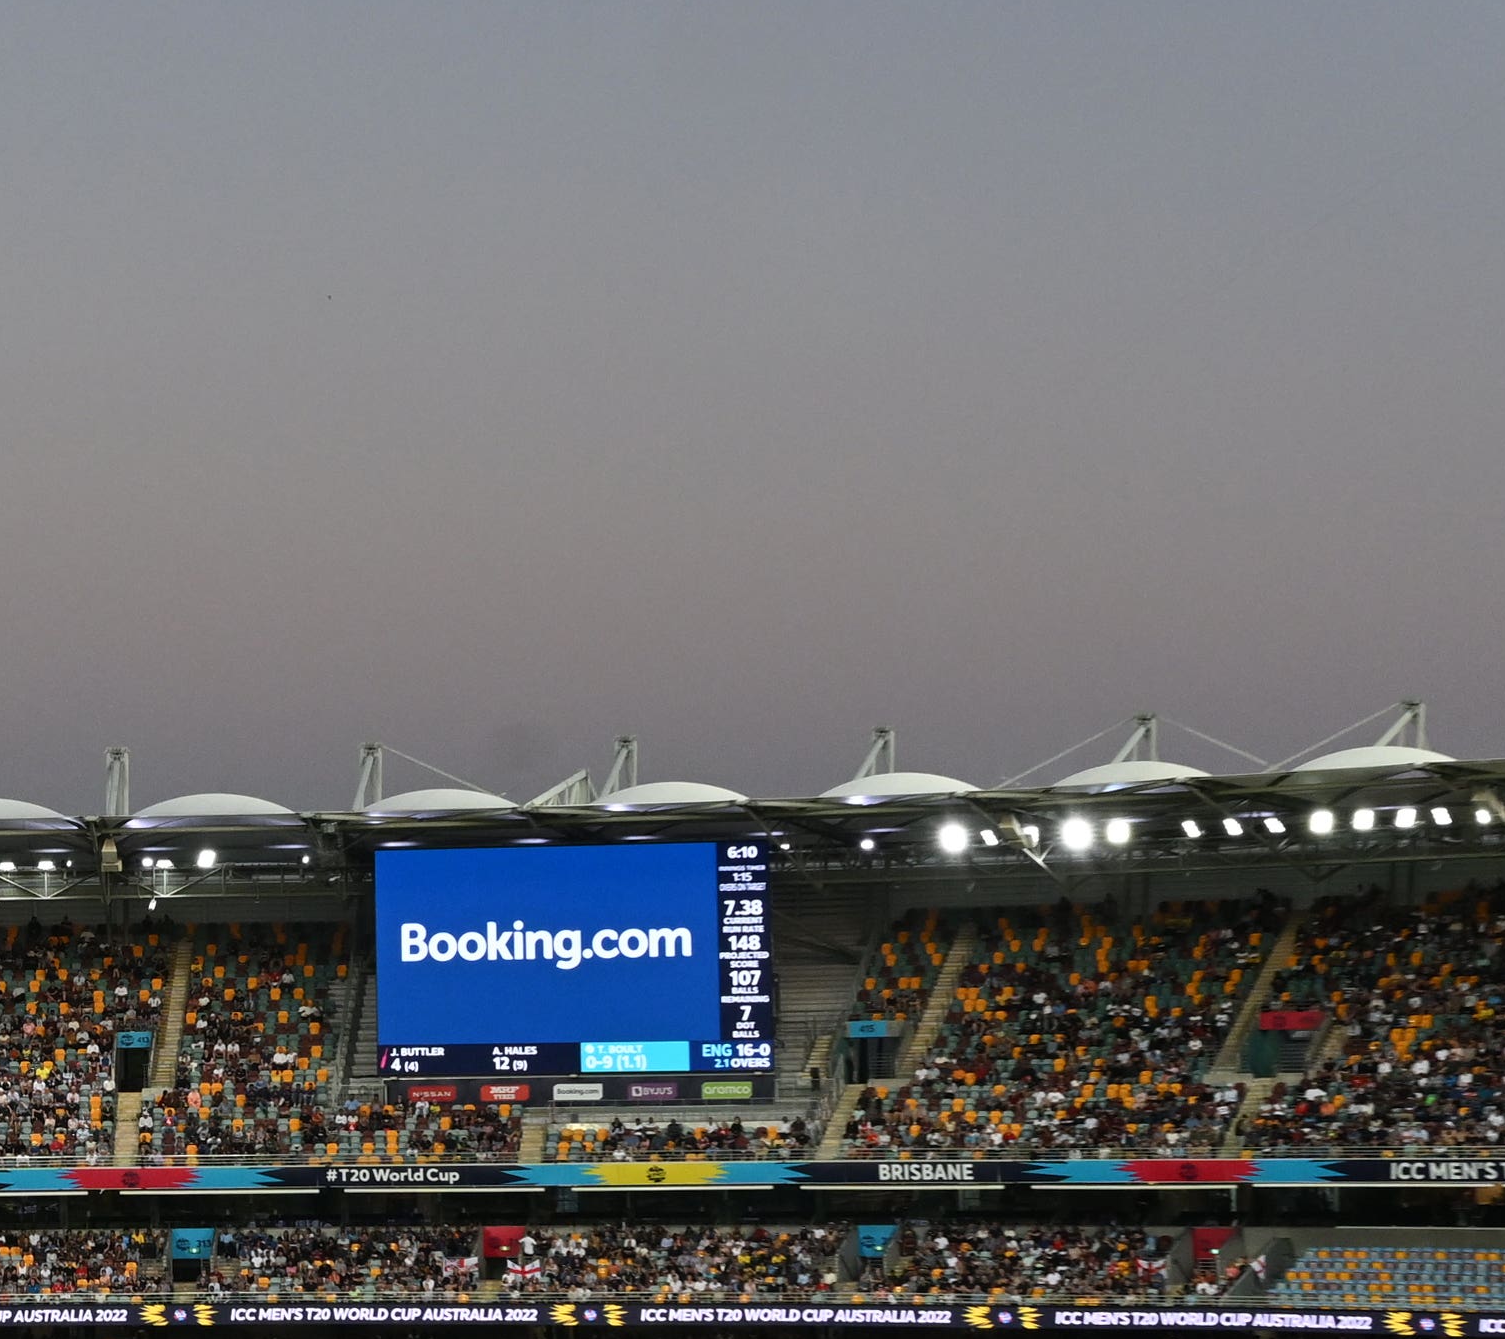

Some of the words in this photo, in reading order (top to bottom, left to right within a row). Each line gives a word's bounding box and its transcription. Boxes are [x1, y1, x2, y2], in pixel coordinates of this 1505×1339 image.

[727, 845, 758, 859] 6:10
[723, 899, 763, 915] 7.38
[723, 917, 763, 925] CURRENT
[722, 925, 742, 933] RUN
[742, 925, 764, 933] RATE
[400, 919, 692, 969] Booking.com
[728, 935, 761, 950] 148
[719, 951, 769, 960] PROJECTED
[730, 960, 759, 968] SCORE
[729, 970, 762, 985] 107
[731, 986, 759, 994] BALLS
[720, 994, 770, 1003] REMAINING
[739, 1005, 752, 1021] 7
[736, 1021, 755, 1029] DOT
[732, 1029, 759, 1038] BALLS
[390, 1047, 399, 1057] J.
[400, 1047, 445, 1056] BUTTLER
[492, 1046, 503, 1055] A.
[504, 1046, 537, 1055] HALES
[609, 1045, 643, 1054] BOULT
[702, 1044, 732, 1057] ENG
[736, 1044, 770, 1057] 16-0
[390, 1058, 401, 1071] 4
[404, 1060, 419, 1072] (4)
[493, 1057, 510, 1070] 12
[512, 1060, 528, 1071] (9)
[585, 1055, 614, 1069] 0-9
[617, 1054, 647, 1071] (1.1)
[714, 1058, 730, 1068] 2.1
[730, 1058, 770, 1068] OVERS
[412, 1091, 451, 1099] NISSAN
[557, 1088, 599, 1097] Booking.com
[642, 1087, 673, 1095] BYJU'S
[704, 1086, 750, 1095] aramco
[326, 1168, 369, 1183] #T20
[372, 1168, 424, 1183] World
[426, 1168, 460, 1185] Cup
[878, 1164, 974, 1181] BRISBANE
[1390, 1162, 1426, 1180] ICC
[1429, 1162, 1498, 1180] MEN'S
[13, 1309, 91, 1323] AUSTRALIA
[95, 1309, 127, 1322] 2022
[231, 1308, 257, 1321] ICC
[258, 1308, 303, 1321] MEN'S
[305, 1308, 330, 1321] T20
[332, 1308, 389, 1321] WORLD
[391, 1308, 421, 1321] CUP
[422, 1308, 503, 1321] AUSTRALIA
[505, 1308, 538, 1321] 2022
[641, 1309, 667, 1322] ICC
[669, 1309, 715, 1322] MEN'S
[716, 1309, 742, 1322] T20
[744, 1309, 801, 1322] WORLD
[802, 1310, 833, 1323] CUP
[834, 1310, 916, 1323] AUSTRALIA
[917, 1311, 952, 1324] 2022
